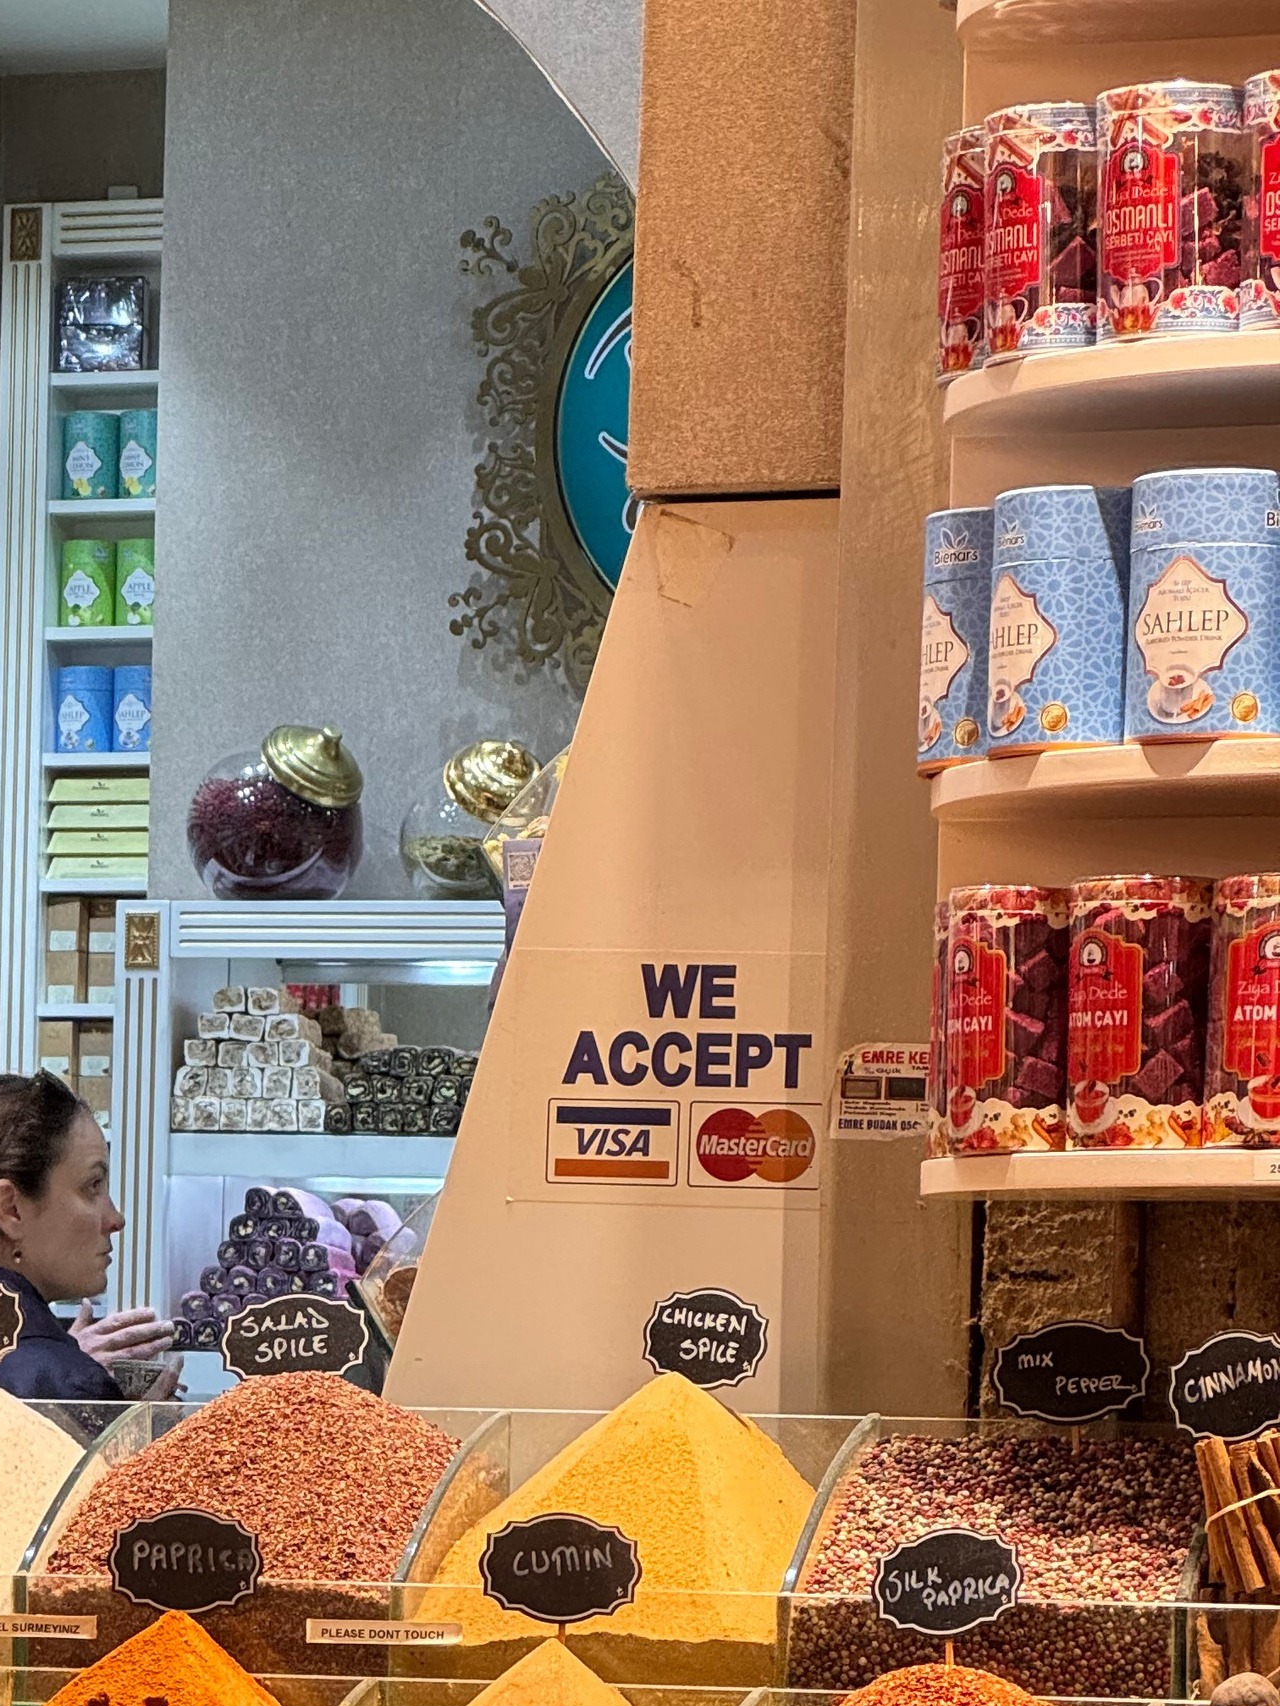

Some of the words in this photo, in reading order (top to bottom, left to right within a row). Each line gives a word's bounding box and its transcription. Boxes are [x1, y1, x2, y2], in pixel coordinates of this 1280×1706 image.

[1106, 203, 1173, 234] OSMANLI
[934, 550, 978, 565] Bienars
[1142, 609, 1229, 636] SAHLEP
[641, 963, 737, 1019] WE
[1090, 980, 1128, 1001] Dede
[963, 1016, 993, 1035] ÇAYI
[1094, 1010, 1128, 1030] ÇAYI
[1232, 1004, 1277, 1022] ATOM
[562, 1030, 812, 1089] ACCEPT
[862, 1051, 905, 1064] EMRE
[838, 1118, 864, 1130] EMRE
[573, 1128, 651, 1157] VISA
[698, 1134, 812, 1158] MasterCard
[239, 1306, 330, 1339] SALAD
[661, 1305, 748, 1335] CHICKEN
[253, 1334, 328, 1365] SPICE
[679, 1337, 739, 1364] SPICE
[1055, 1375, 1129, 1395] PEPPER
[131, 1539, 253, 1577] PAPRICA
[886, 1566, 942, 1603] SILK
[922, 1573, 1010, 1611] PAPRICA
[11, 1623, 81, 1635] SURMEYINIZ
[321, 1628, 366, 1640] PLEASE
[368, 1629, 401, 1640] DONT
[404, 1630, 445, 1641] TOUCH
